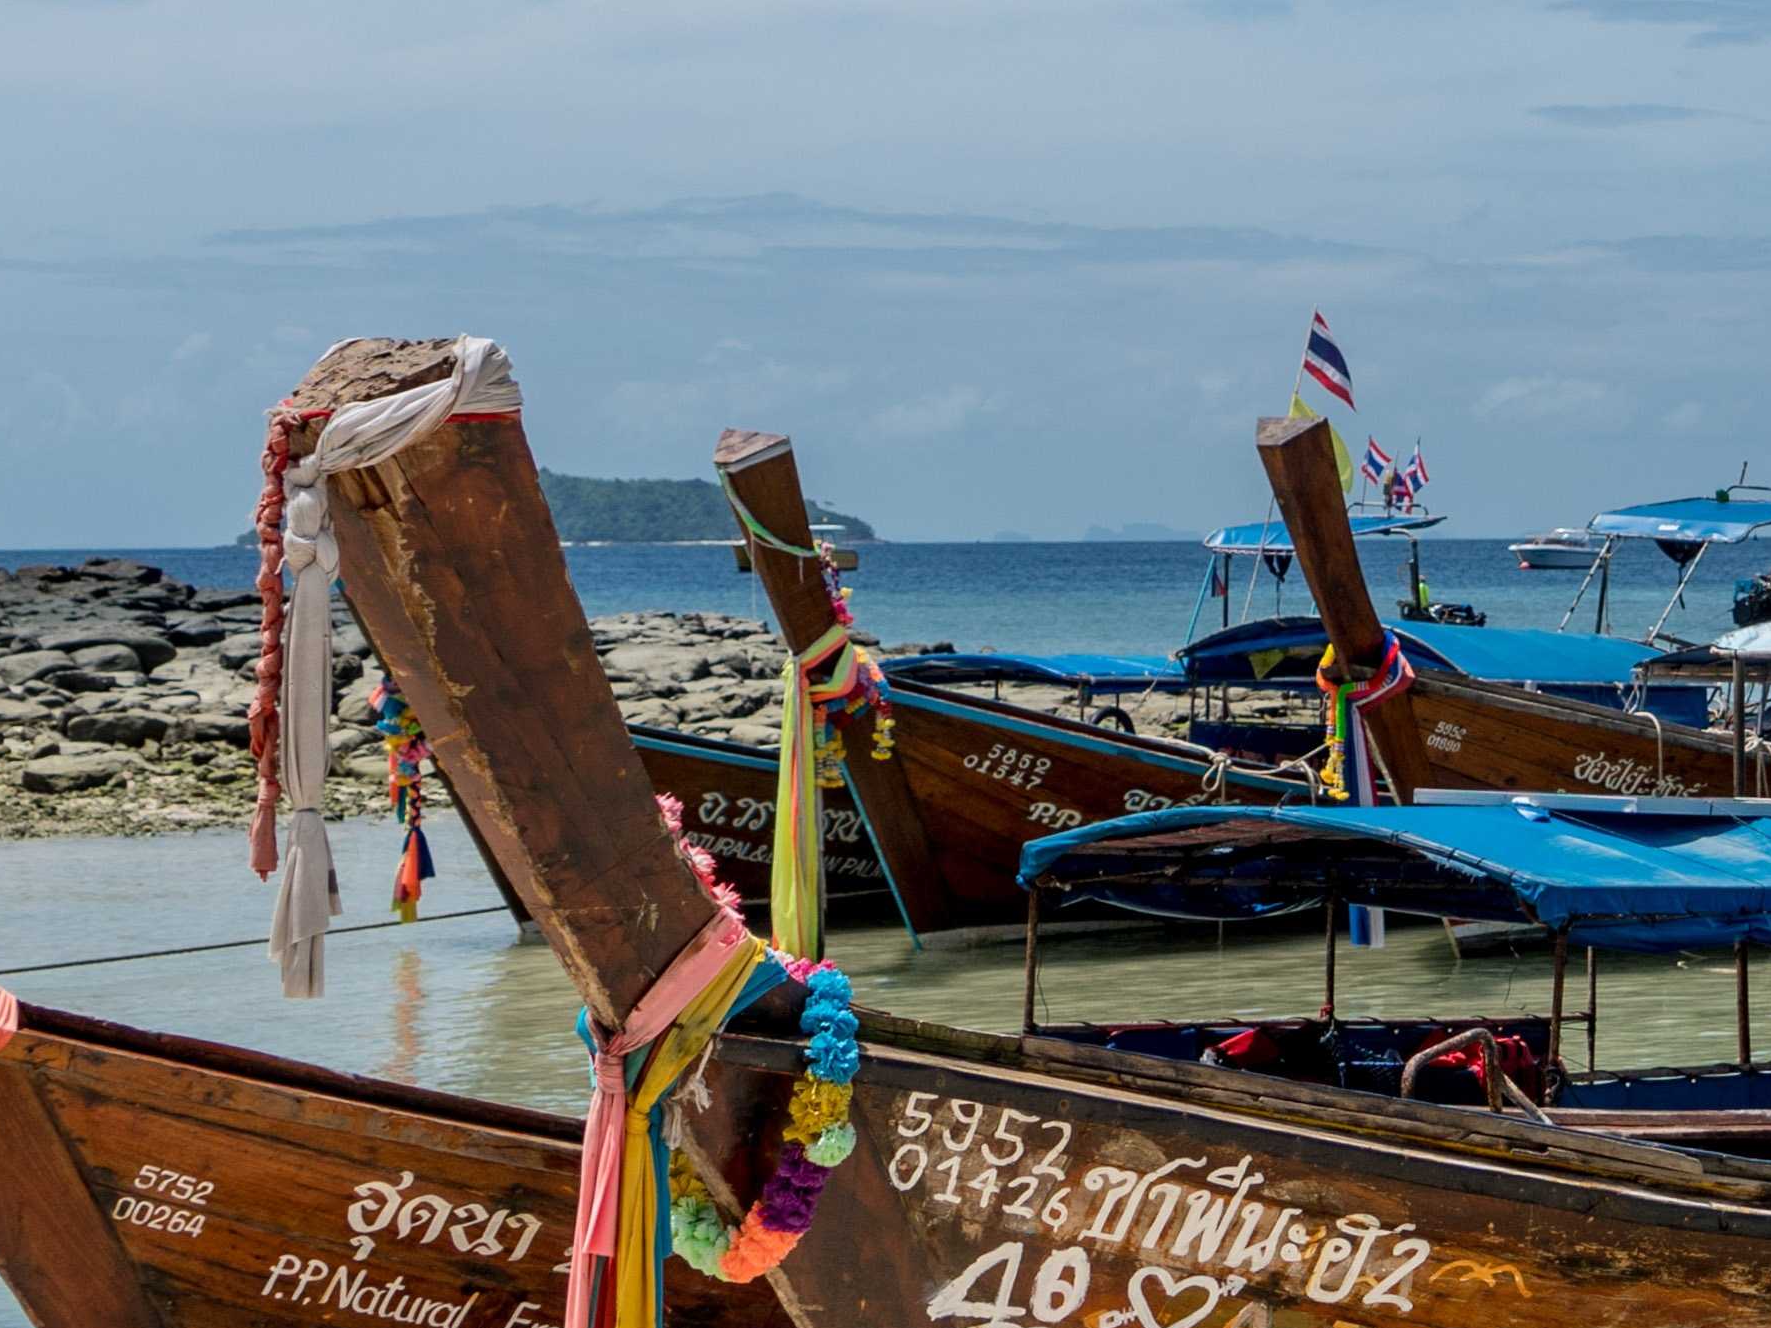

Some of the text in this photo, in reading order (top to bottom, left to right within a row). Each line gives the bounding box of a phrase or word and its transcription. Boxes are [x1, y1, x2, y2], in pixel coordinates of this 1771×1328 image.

[963, 754, 1043, 792] 01547
[987, 743, 1052, 776] 5852
[897, 1091, 1073, 1181] 5952
[133, 1164, 215, 1206] 5752
[889, 1143, 1071, 1233] 01426
[112, 1196, 206, 1238] 00264
